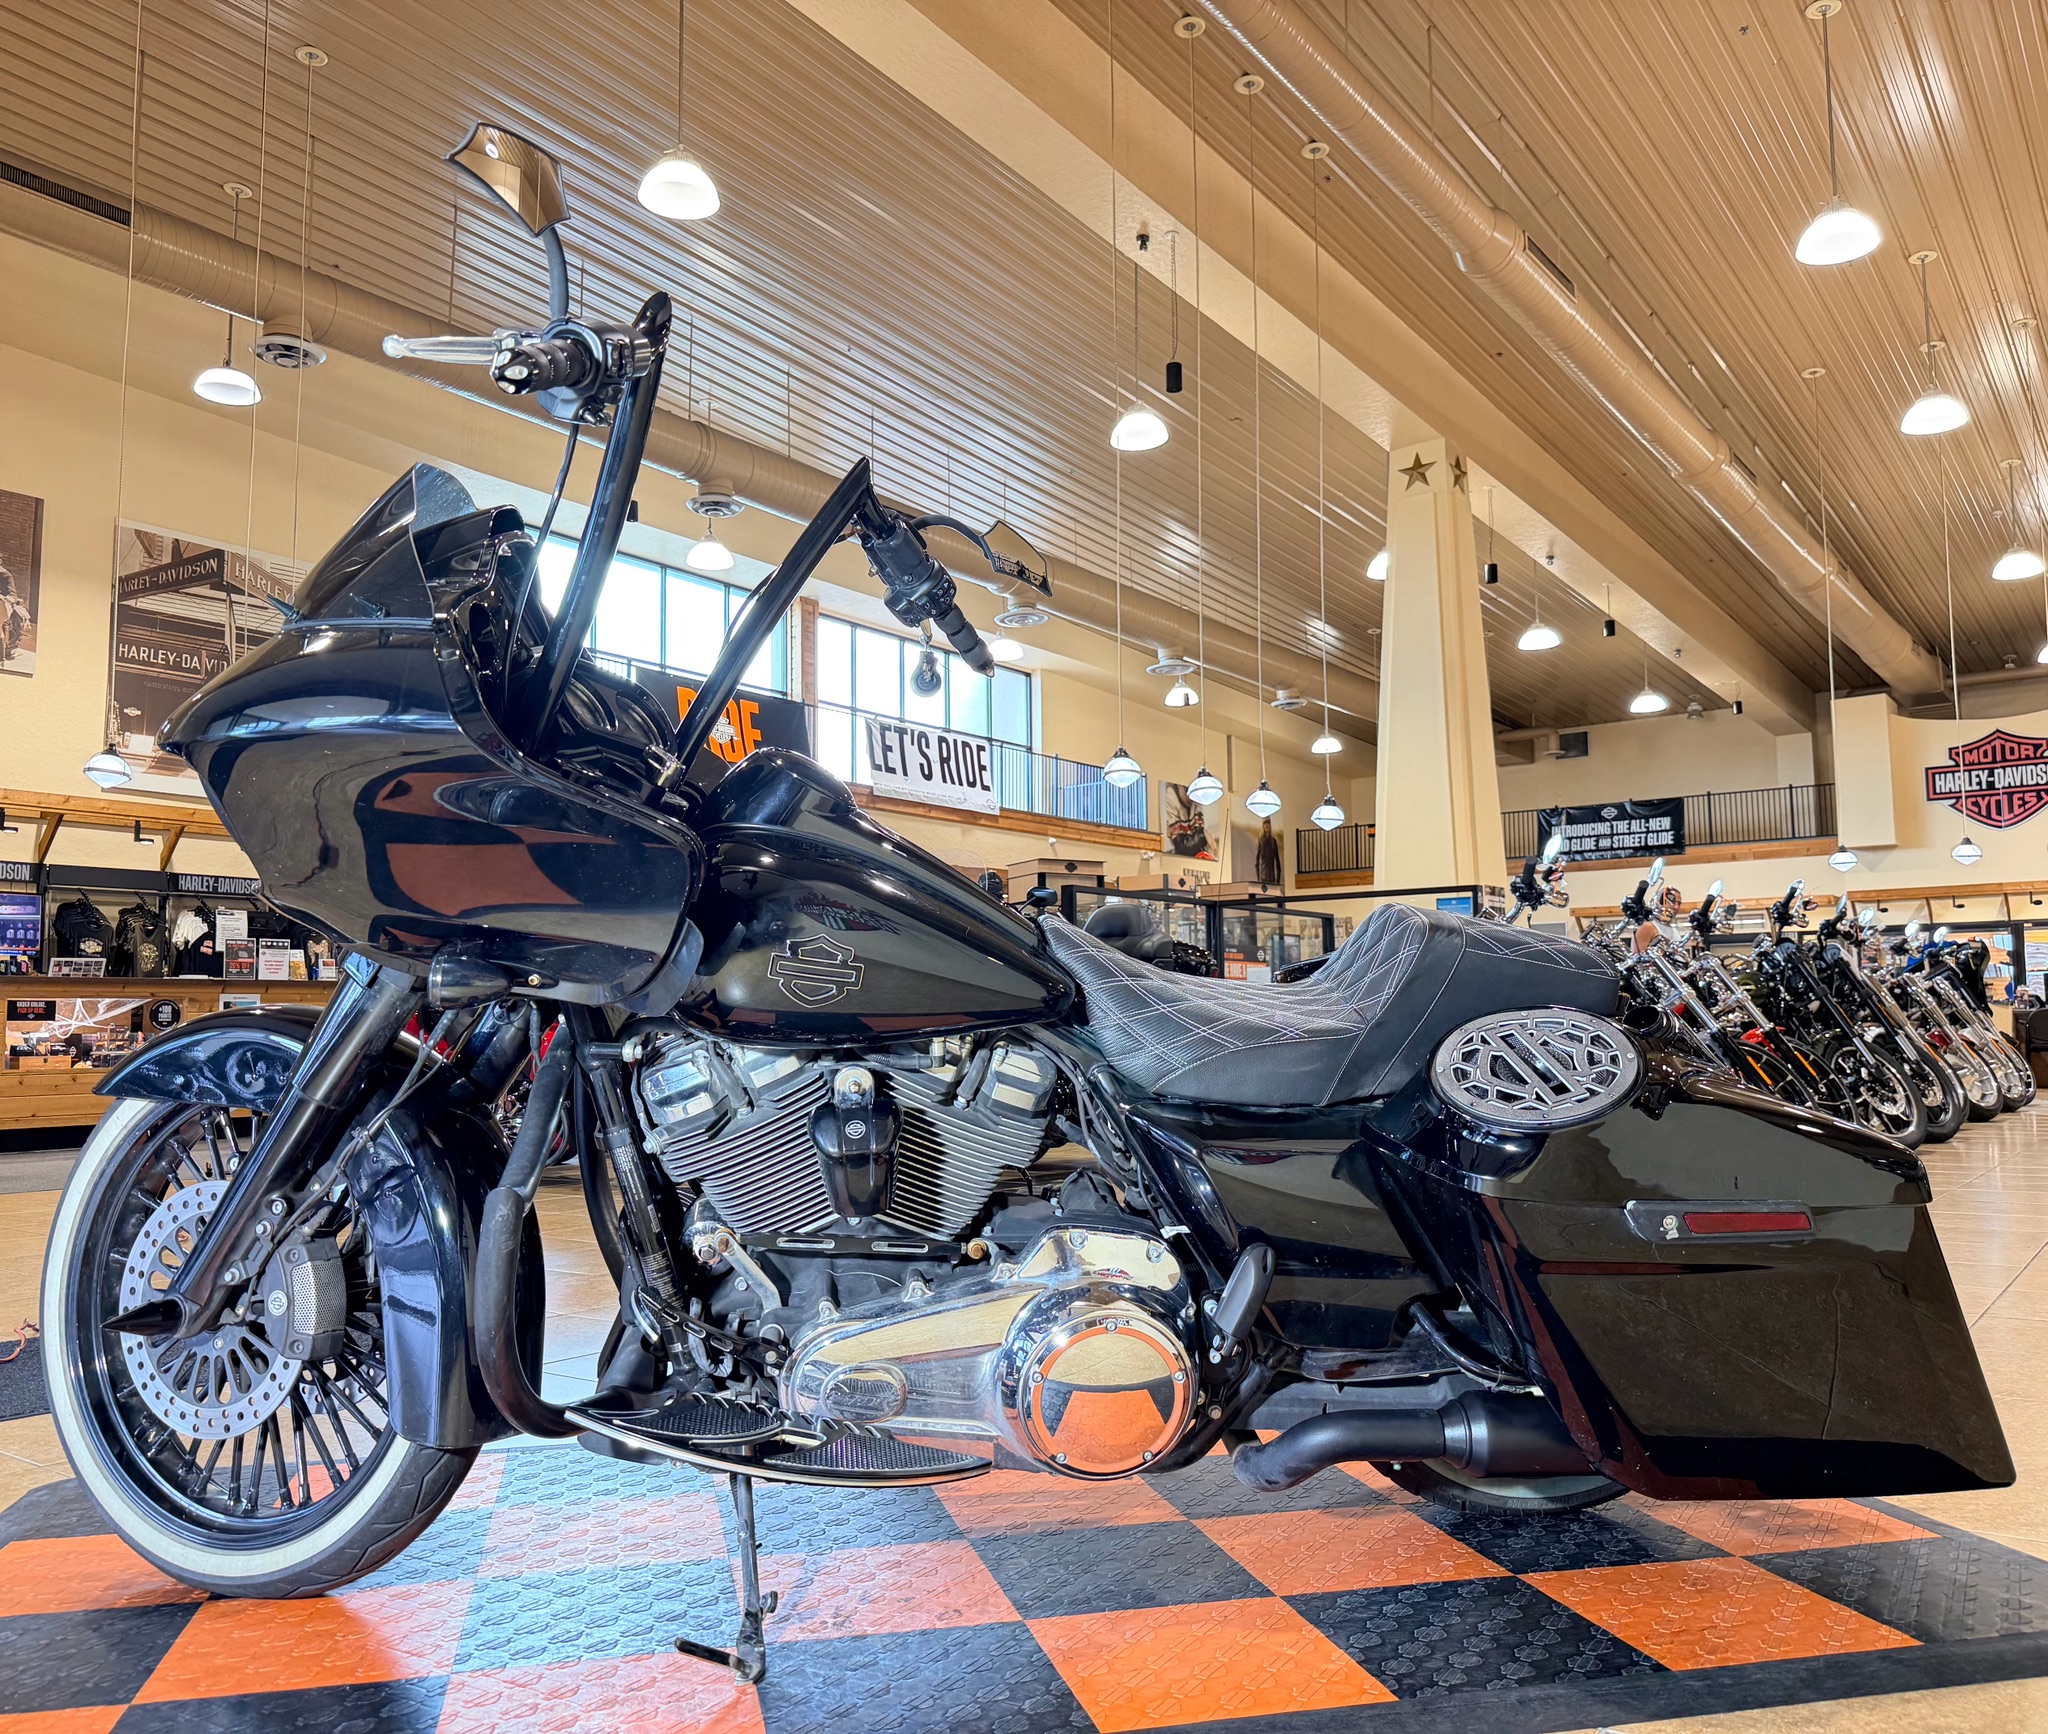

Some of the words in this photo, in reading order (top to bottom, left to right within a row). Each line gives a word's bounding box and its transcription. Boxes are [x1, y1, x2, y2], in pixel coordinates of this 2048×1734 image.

[865, 719, 934, 782] LET'S
[937, 734, 992, 792] RIDE
[1964, 738, 2035, 765] MOTOR
[1934, 763, 2048, 794] HARLEY-DAVIDS
[1966, 791, 2038, 821] CYCLES
[1551, 821, 1611, 838] INTRODUCING
[1611, 819, 1630, 834] THE
[1630, 816, 1671, 832] ALL-NEW
[1571, 837, 1597, 852] GLIDE
[1598, 838, 1611, 848] AND
[1612, 833, 1647, 849] STREET
[1647, 831, 1675, 846] GLIDE
